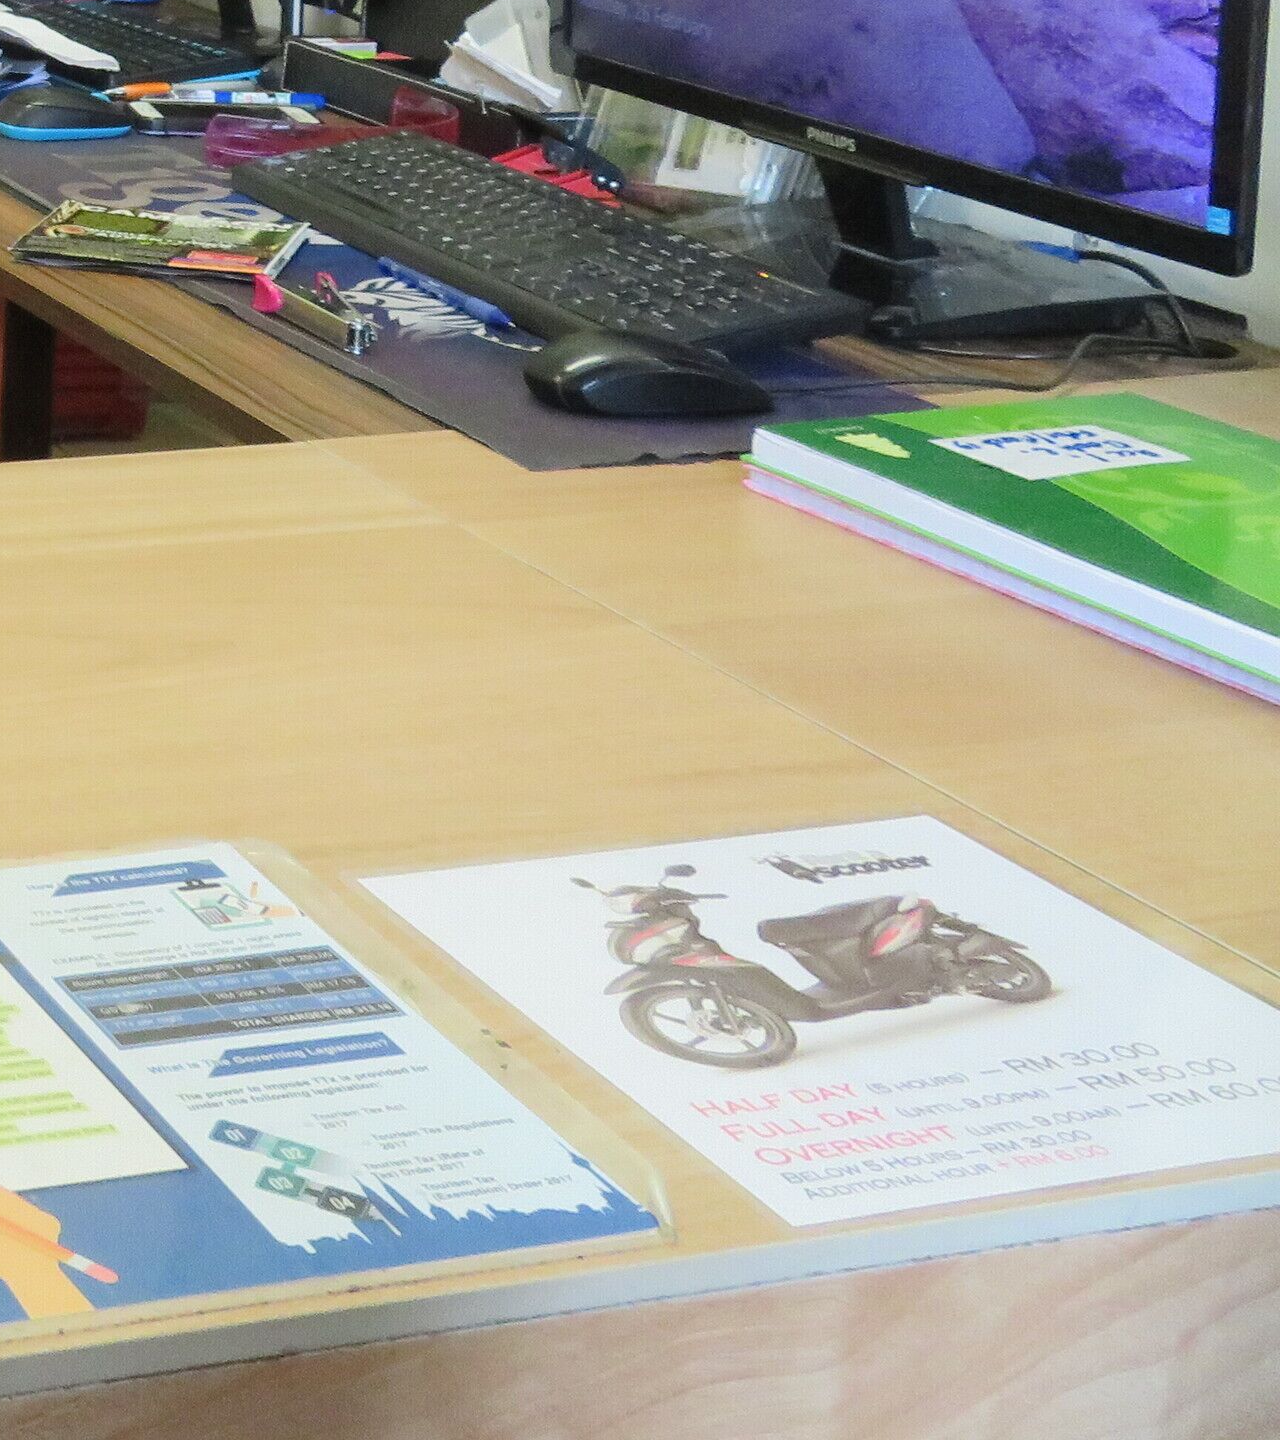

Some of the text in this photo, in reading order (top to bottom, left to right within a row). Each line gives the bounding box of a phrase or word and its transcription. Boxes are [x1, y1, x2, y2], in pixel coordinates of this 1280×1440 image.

[233, 1047, 306, 1065] Governing
[307, 1038, 391, 1058] Legislation?
[176, 1091, 202, 1102] The
[205, 1088, 245, 1100] power
[263, 1079, 310, 1092] impose
[355, 1066, 410, 1082] provided
[413, 1063, 430, 1072] for
[691, 1093, 781, 1118] HALF
[789, 1082, 860, 1105] DAY
[893, 1071, 970, 1094] HOURS)
[1001, 1055, 1064, 1075] RM
[1059, 1042, 1160, 1067] 30.00
[187, 1101, 225, 1112] under
[227, 1097, 248, 1106] the
[250, 1089, 312, 1104] following
[720, 1118, 821, 1142] FULL
[819, 1105, 888, 1129] DAY
[895, 1103, 963, 1119] (UNTIL
[1077, 1070, 1141, 1092] RM
[1134, 1058, 1237, 1083] 50.00
[444, 1116, 515, 1133] Regulations
[753, 1124, 957, 1166] OVERNIGHT
[965, 1121, 1035, 1137] (UNTIL
[1148, 1089, 1210, 1109] RM
[1208, 1075, 1280, 1101] 60.0
[224, 1129, 248, 1142] 01
[280, 1147, 308, 1161] 02
[780, 1128, 1093, 1185] BELOW 5 HOURS RM 30.00
[401, 1165, 435, 1177] Order
[436, 1161, 465, 1172] 2017
[804, 1144, 1110, 1201] ADDITIONAL HOUR RM 6.00
[267, 1176, 294, 1190] 03
[507, 1179, 542, 1191] Order
[543, 1173, 572, 1185] 2017
[329, 1195, 356, 1211] 04
